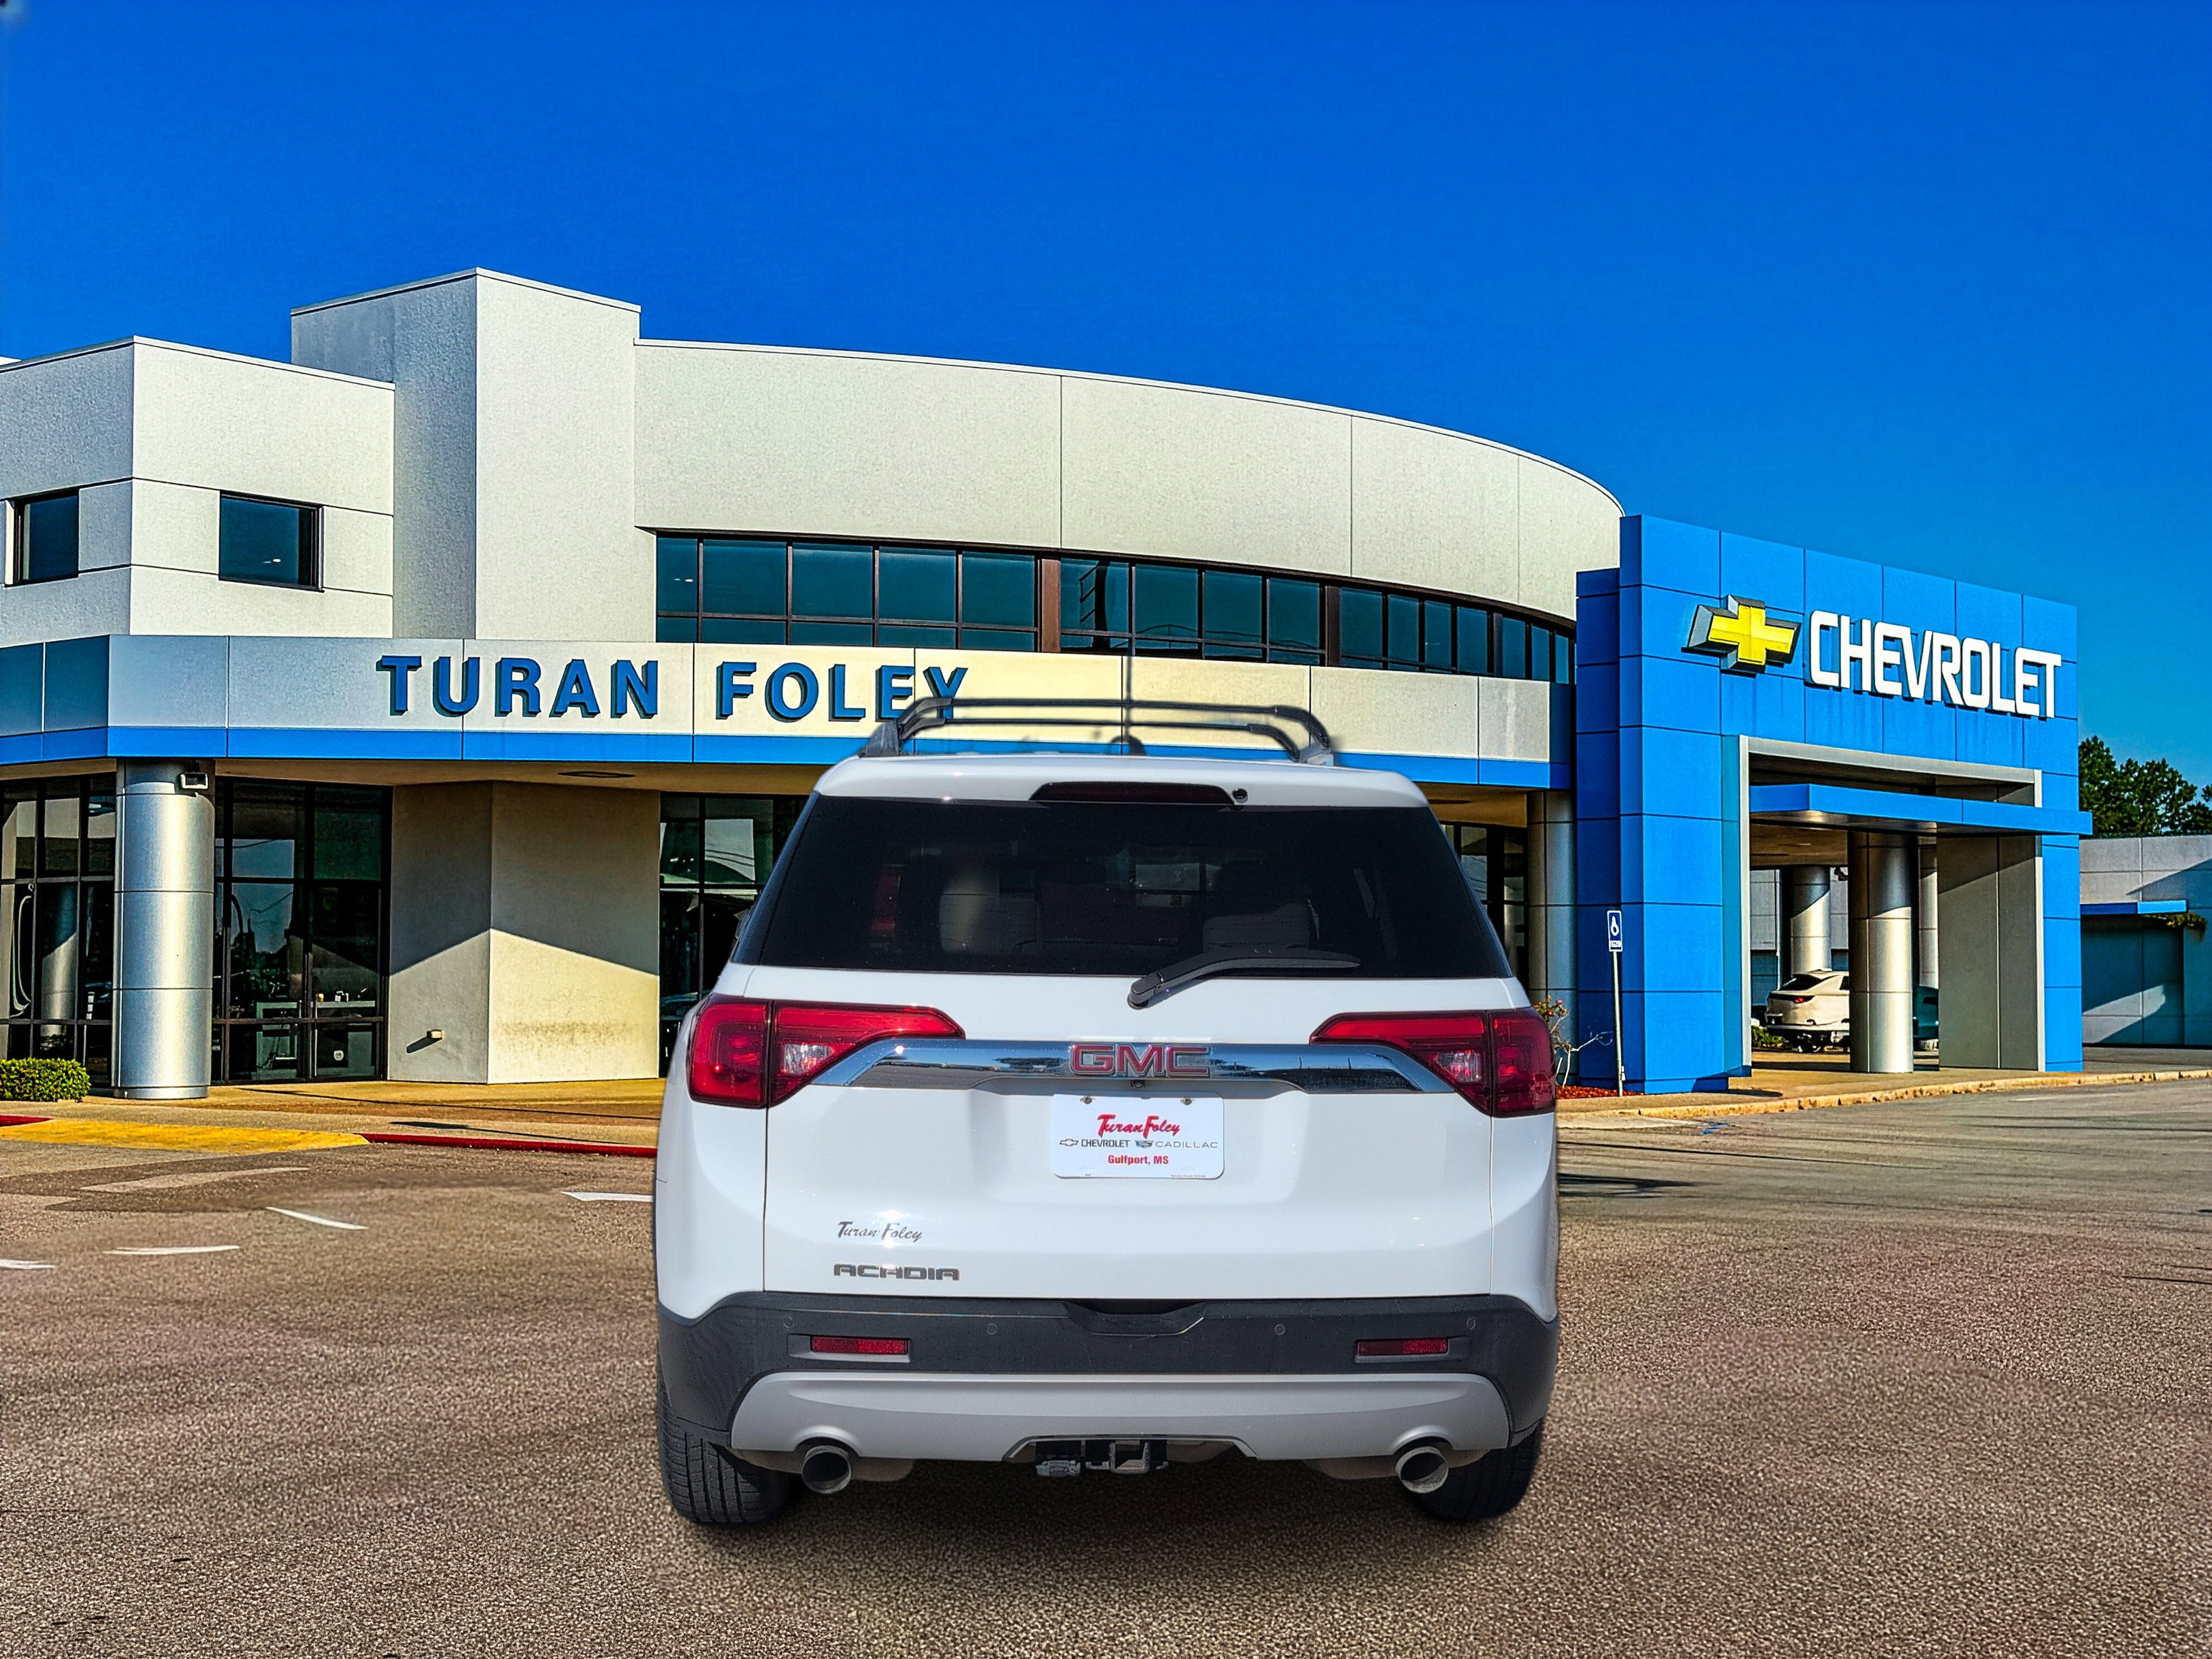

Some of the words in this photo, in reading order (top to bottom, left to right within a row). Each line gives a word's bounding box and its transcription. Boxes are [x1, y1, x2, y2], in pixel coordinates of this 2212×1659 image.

[1809, 610, 2062, 718] CHEVROLET
[376, 655, 658, 719] TURAN
[715, 661, 969, 722] FOLEY
[1070, 1043, 1210, 1077] GMC
[1097, 1114, 1143, 1137] Turan
[1143, 1115, 1181, 1139] Foley
[1081, 1139, 1130, 1148] CHEVROLET
[1108, 1155, 1150, 1165] Gulfport,
[1154, 1156, 1169, 1165] MS
[837, 1221, 878, 1238] Turan
[881, 1223, 923, 1243] Foley
[834, 1263, 960, 1281] ACADIA
